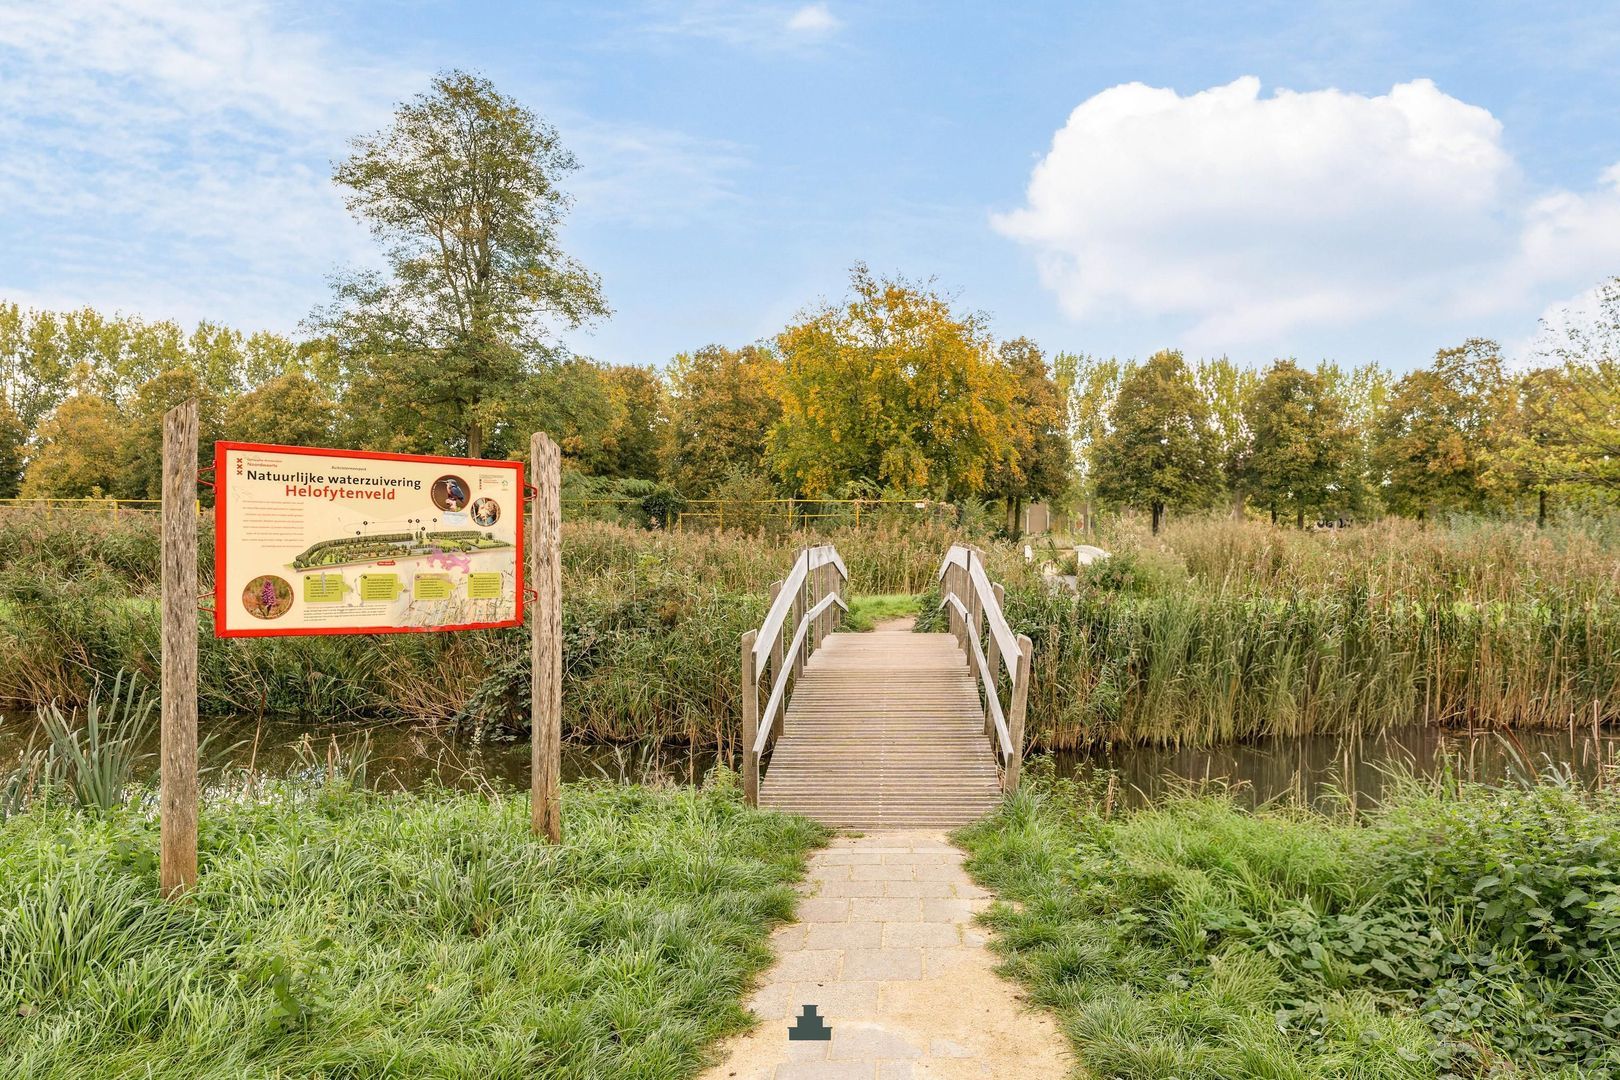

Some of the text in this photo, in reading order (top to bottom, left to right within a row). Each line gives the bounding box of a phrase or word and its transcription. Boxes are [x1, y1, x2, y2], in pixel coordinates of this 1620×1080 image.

[247, 470, 421, 490] Natuurlijke waterzuivering
[286, 485, 395, 501] Helofytenveld
